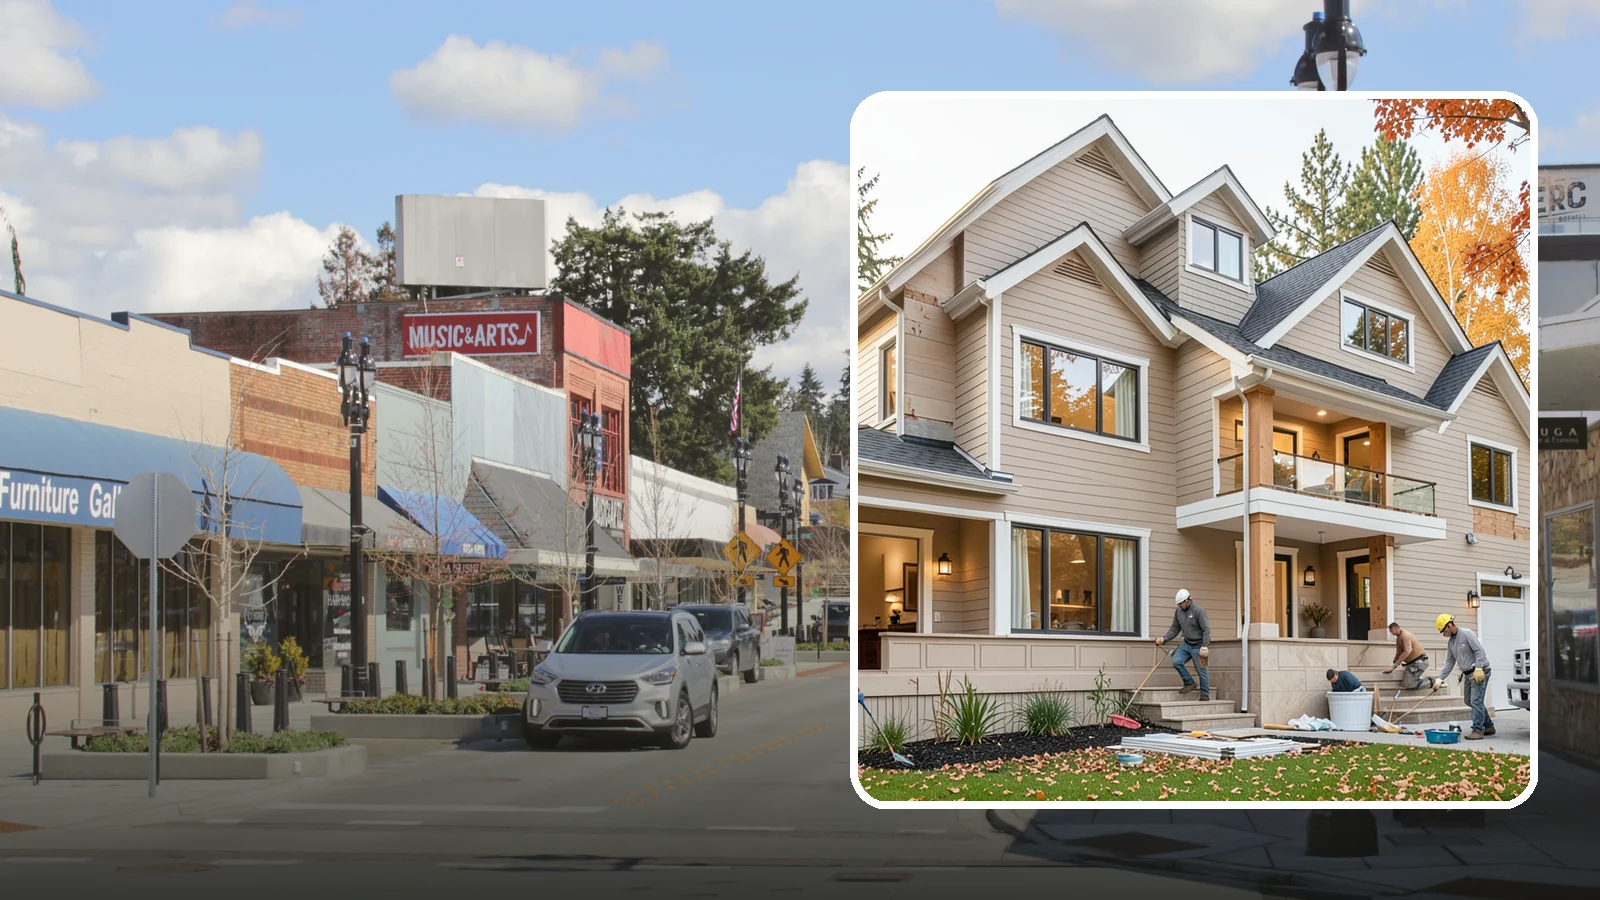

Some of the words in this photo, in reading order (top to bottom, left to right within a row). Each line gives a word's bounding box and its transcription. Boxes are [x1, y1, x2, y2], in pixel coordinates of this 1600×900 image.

[409, 323, 519, 348] MUSIC&ARTS
[0, 471, 79, 515] Furniture
[453, 563, 480, 574] SUSHI
